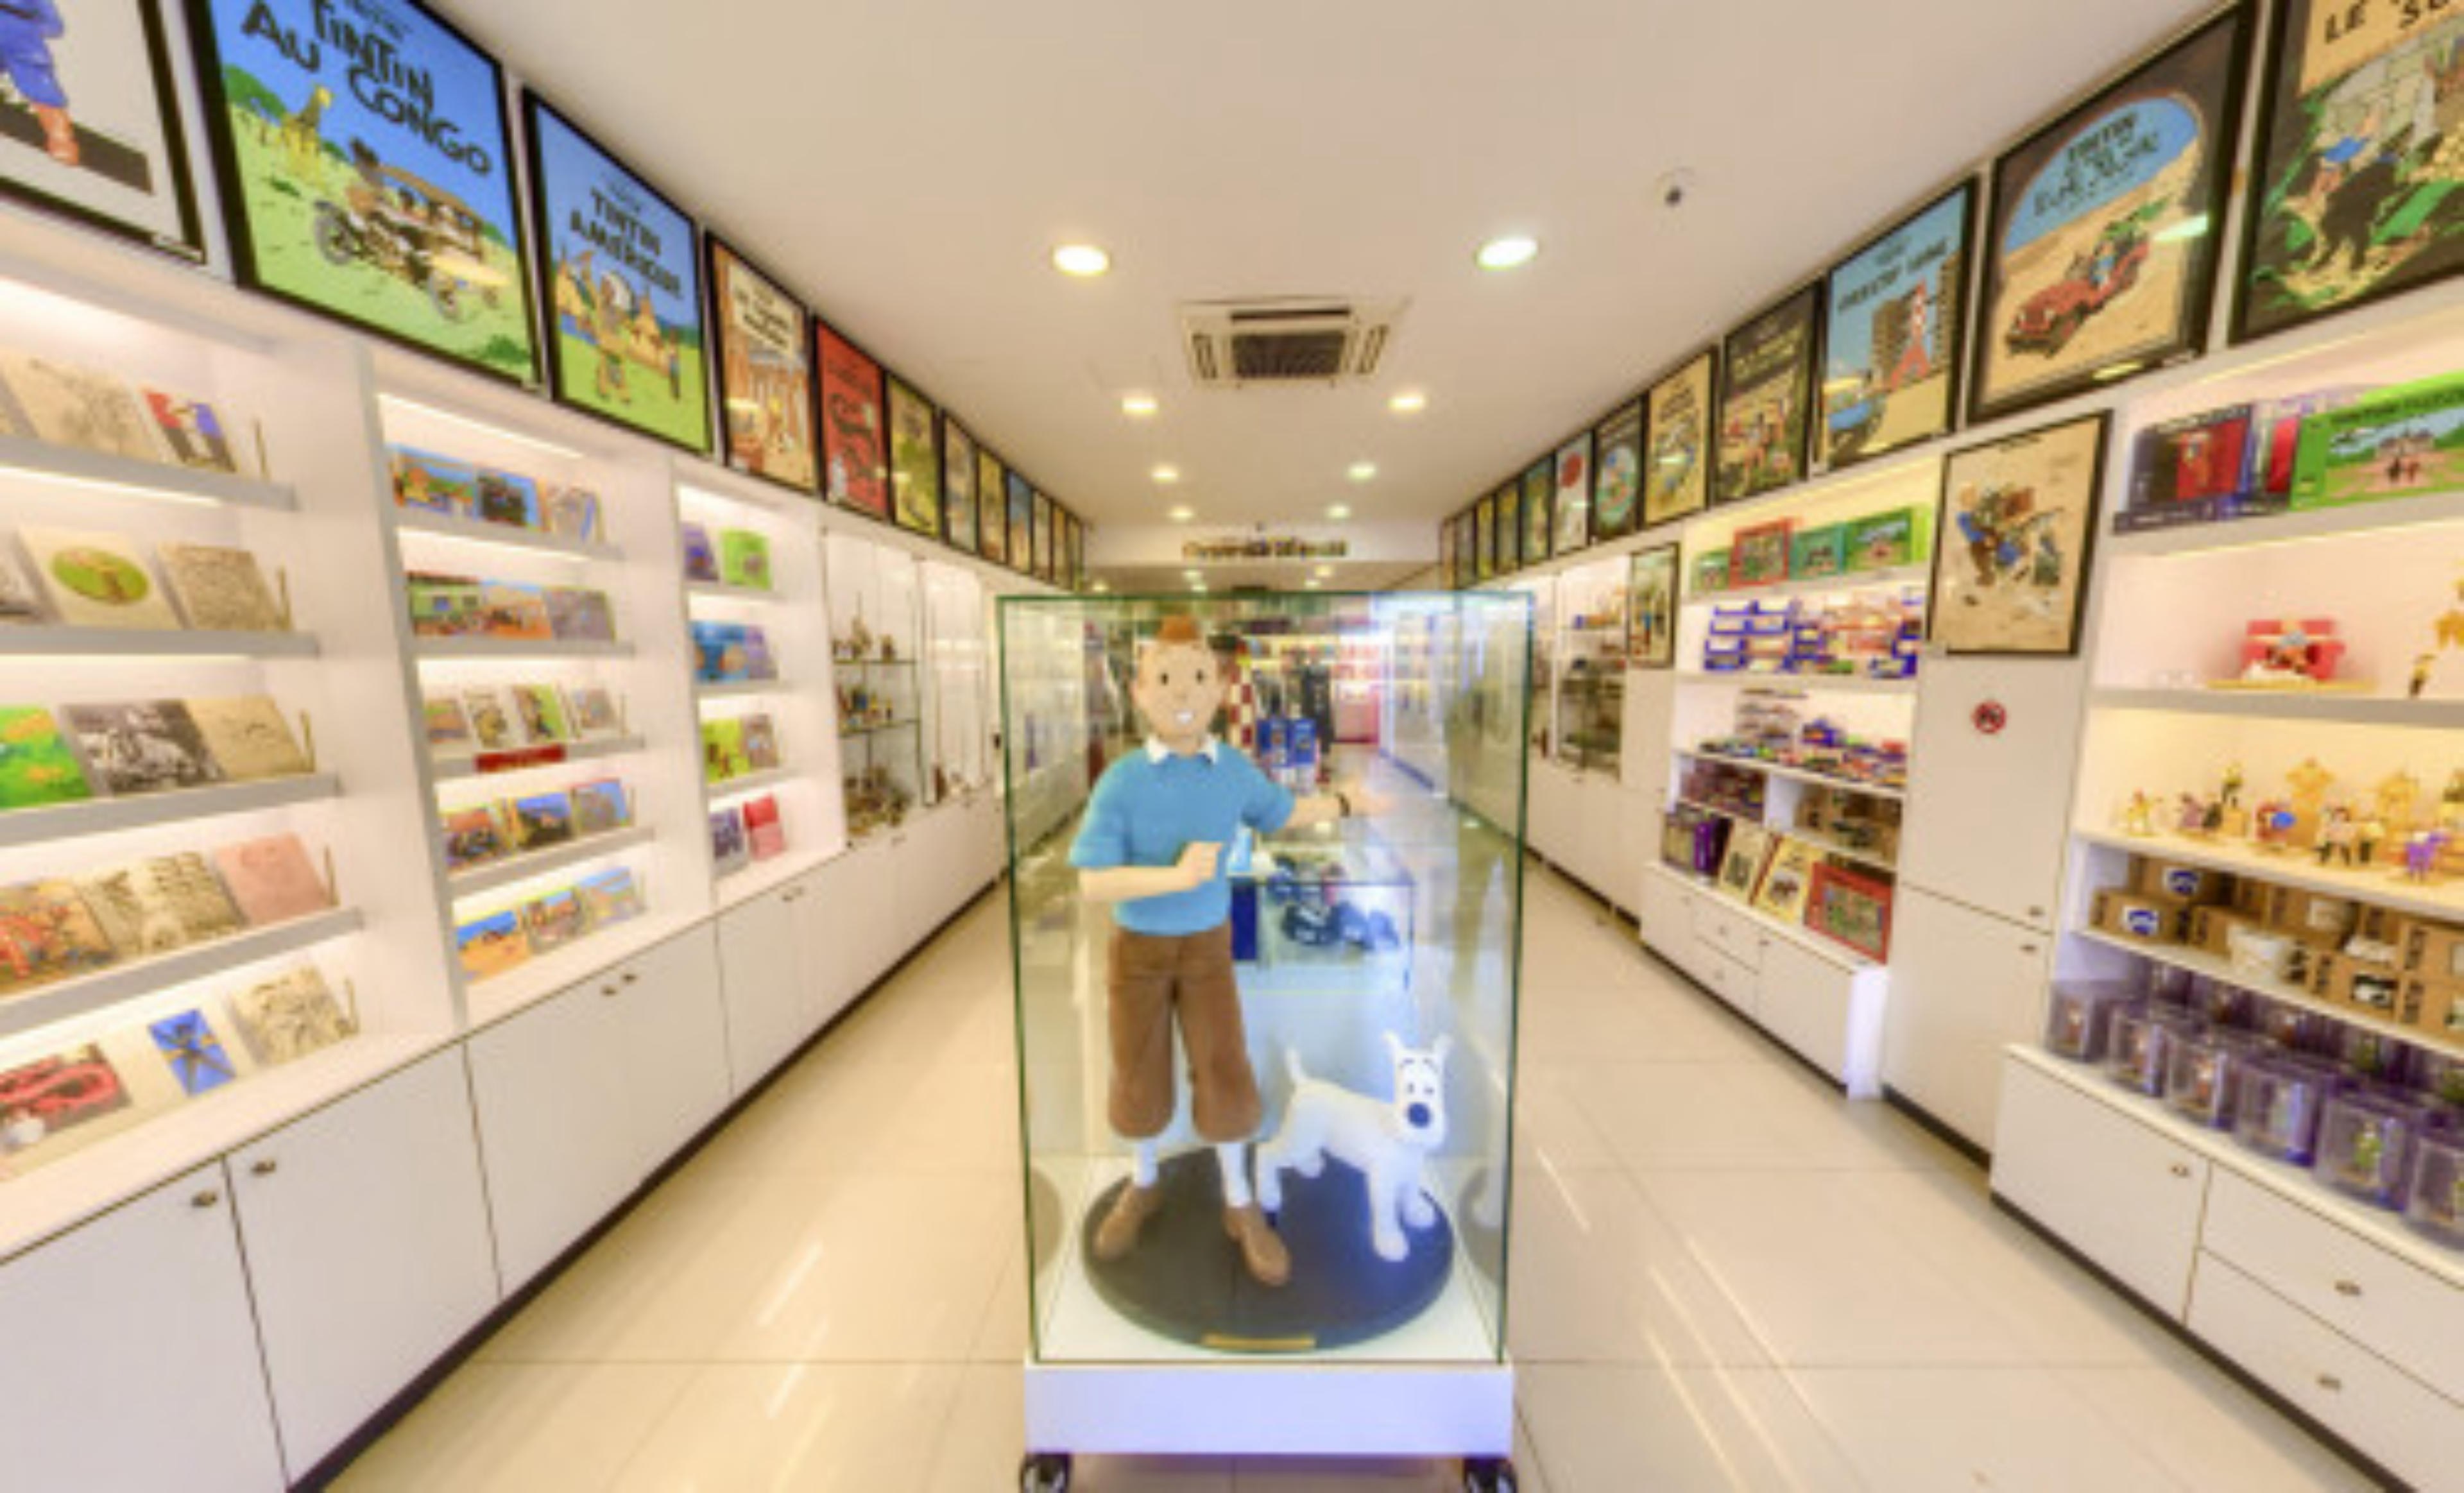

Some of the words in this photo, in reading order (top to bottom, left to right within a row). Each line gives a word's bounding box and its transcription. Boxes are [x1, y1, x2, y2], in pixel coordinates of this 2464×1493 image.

[241, 0, 321, 73] AU
[347, 65, 492, 176] CONGO
[309, 0, 434, 113] TINTIN
